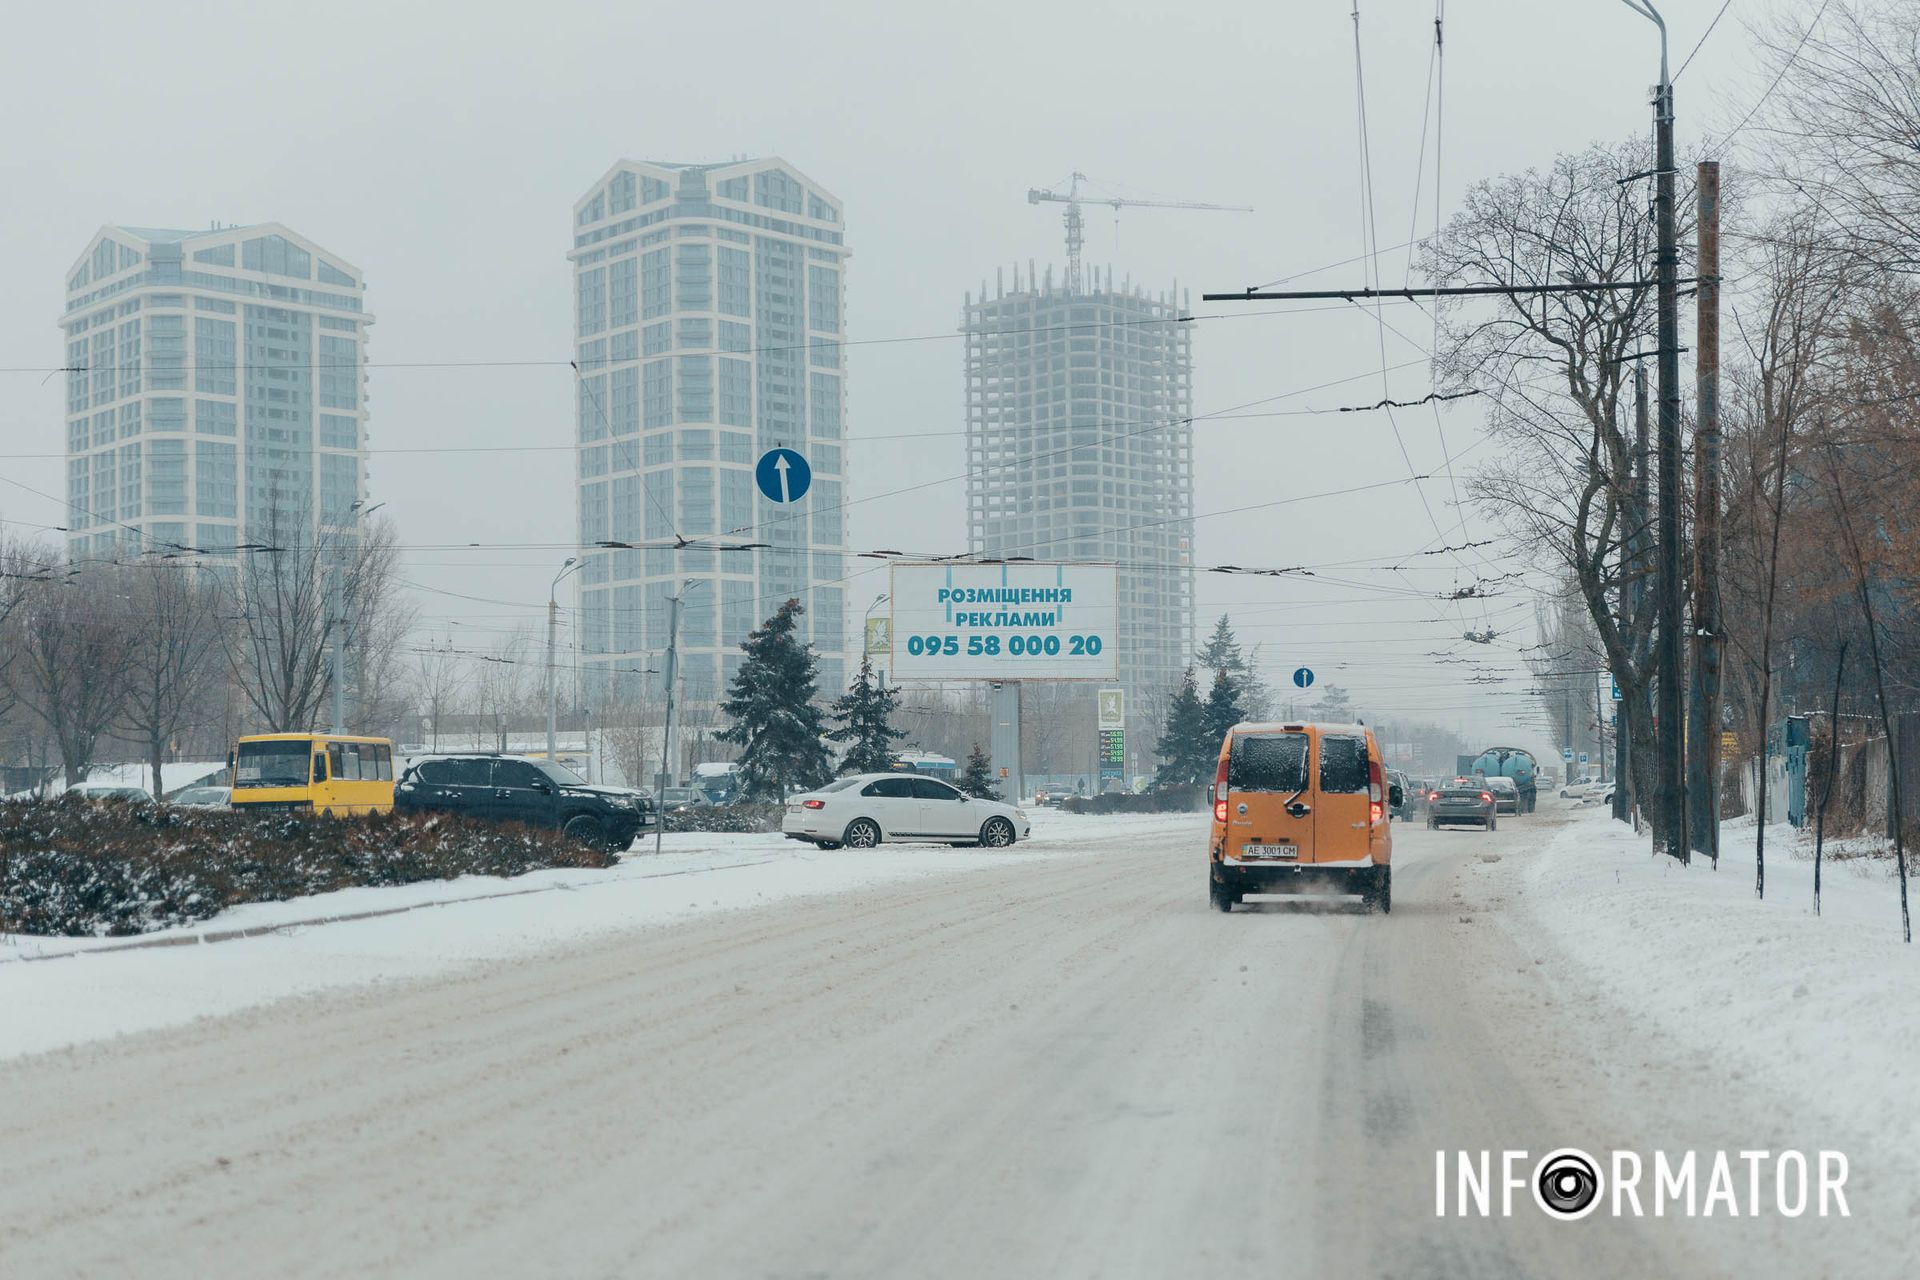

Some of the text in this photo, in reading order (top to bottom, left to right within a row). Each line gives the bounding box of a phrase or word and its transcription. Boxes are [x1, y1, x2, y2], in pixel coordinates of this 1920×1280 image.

[938, 588, 1072, 605] РОЗМІЩЕННЯ
[956, 612, 1055, 627] РЕКЛАМИ
[907, 635, 1102, 656] 095 58 000 20
[1248, 846, 1295, 855] AE 3001 CM
